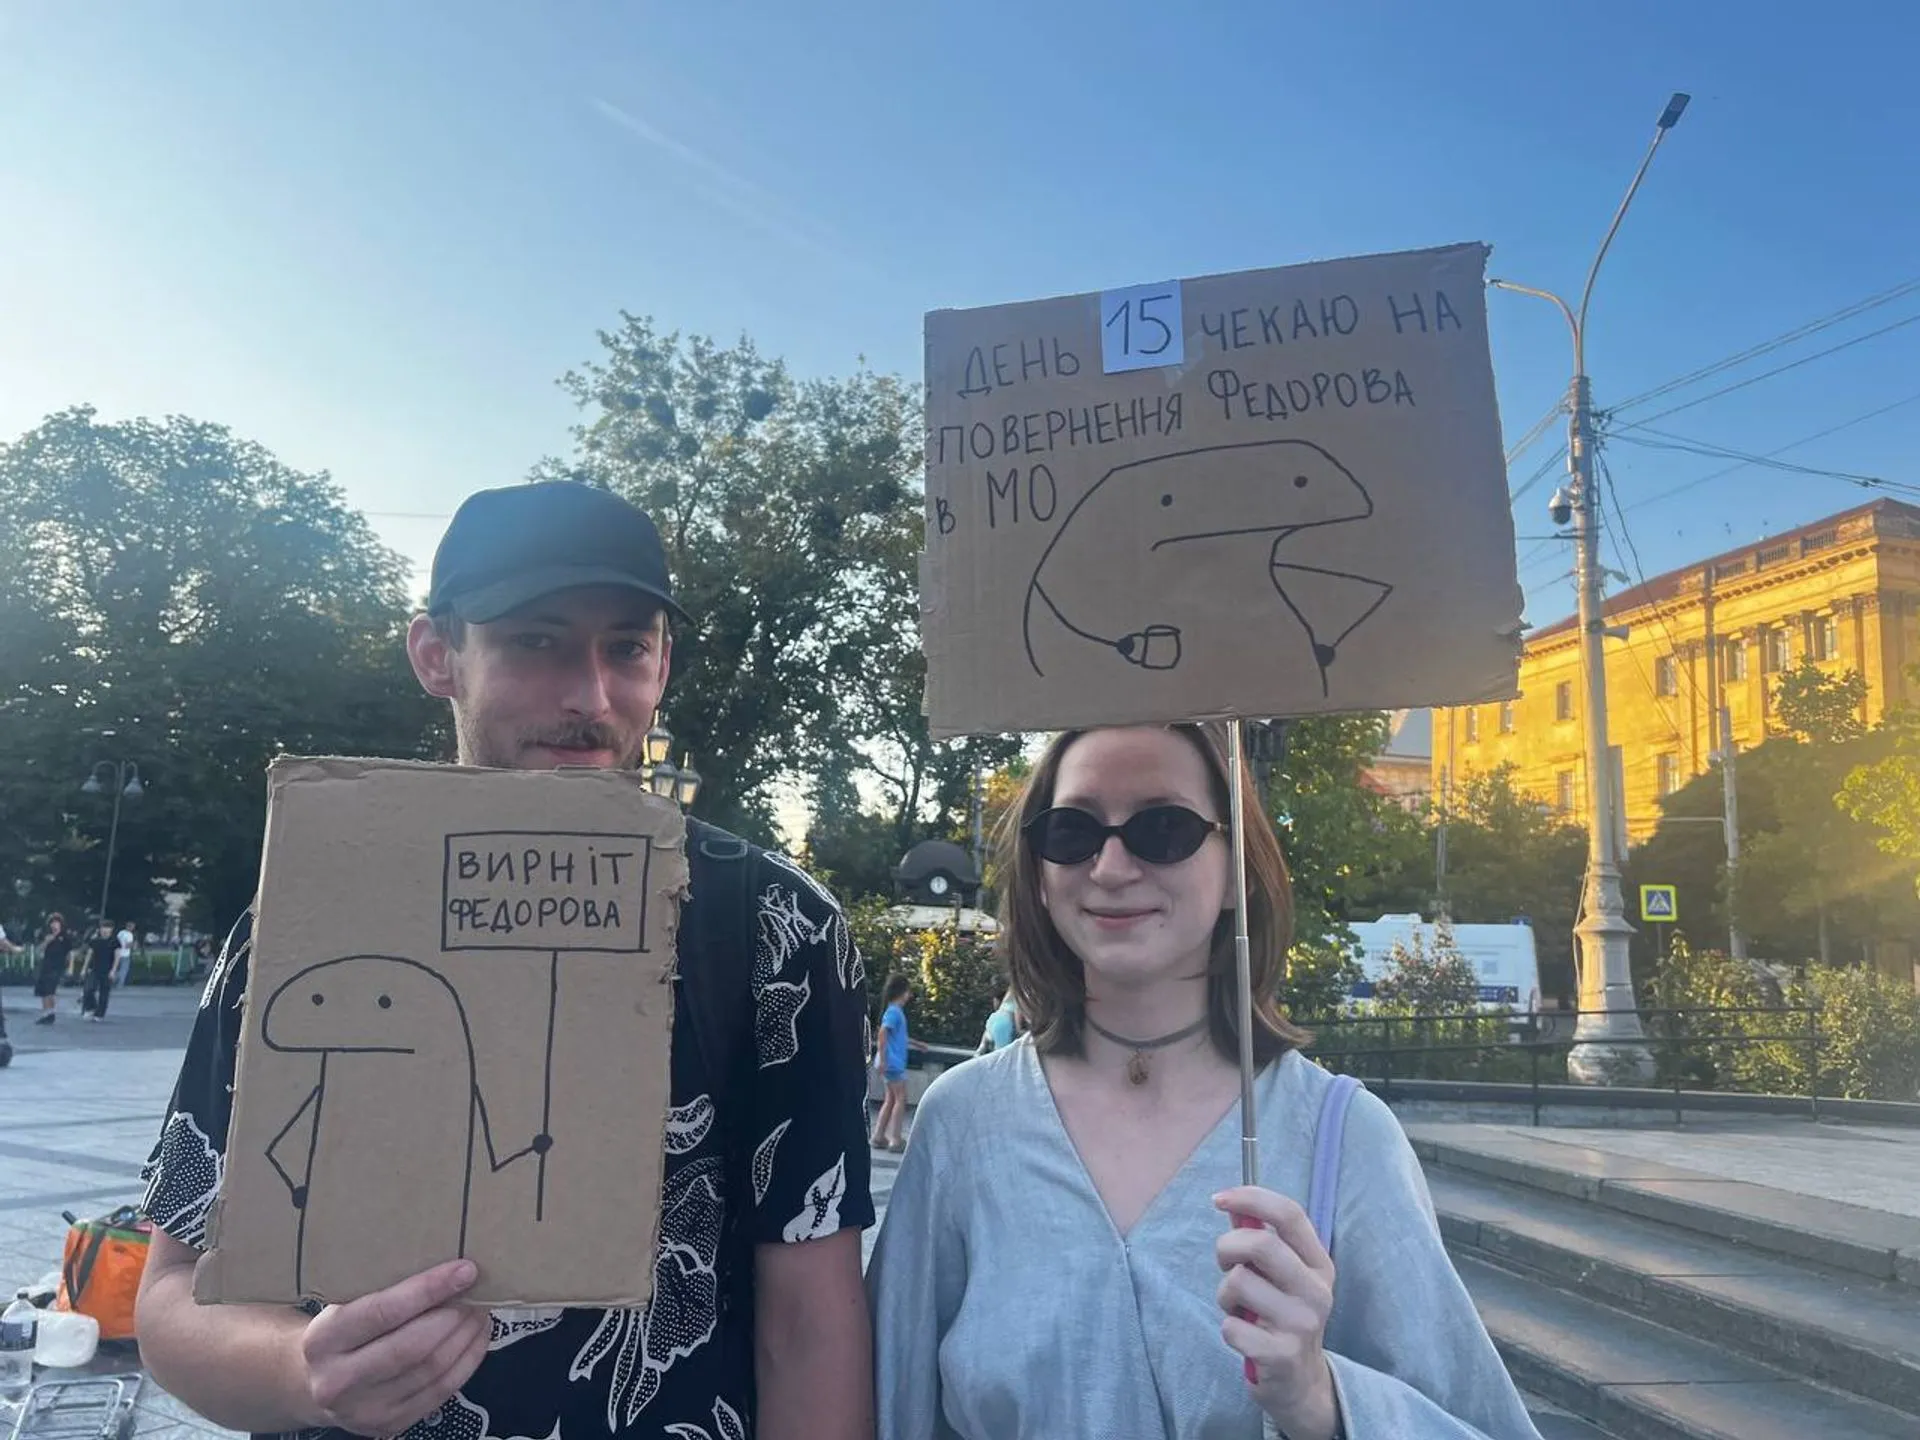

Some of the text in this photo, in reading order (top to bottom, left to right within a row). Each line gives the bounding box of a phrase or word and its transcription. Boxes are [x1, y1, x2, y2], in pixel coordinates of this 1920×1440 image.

[957, 291, 1462, 398] ДЕНЬ 15 ЧЕКАЮ НА
[939, 369, 1416, 464] ПОВЕРНЕННЯ ФЕДОРОВА
[986, 464, 1057, 529] МО
[449, 897, 621, 934] ФЕДОРОВА
